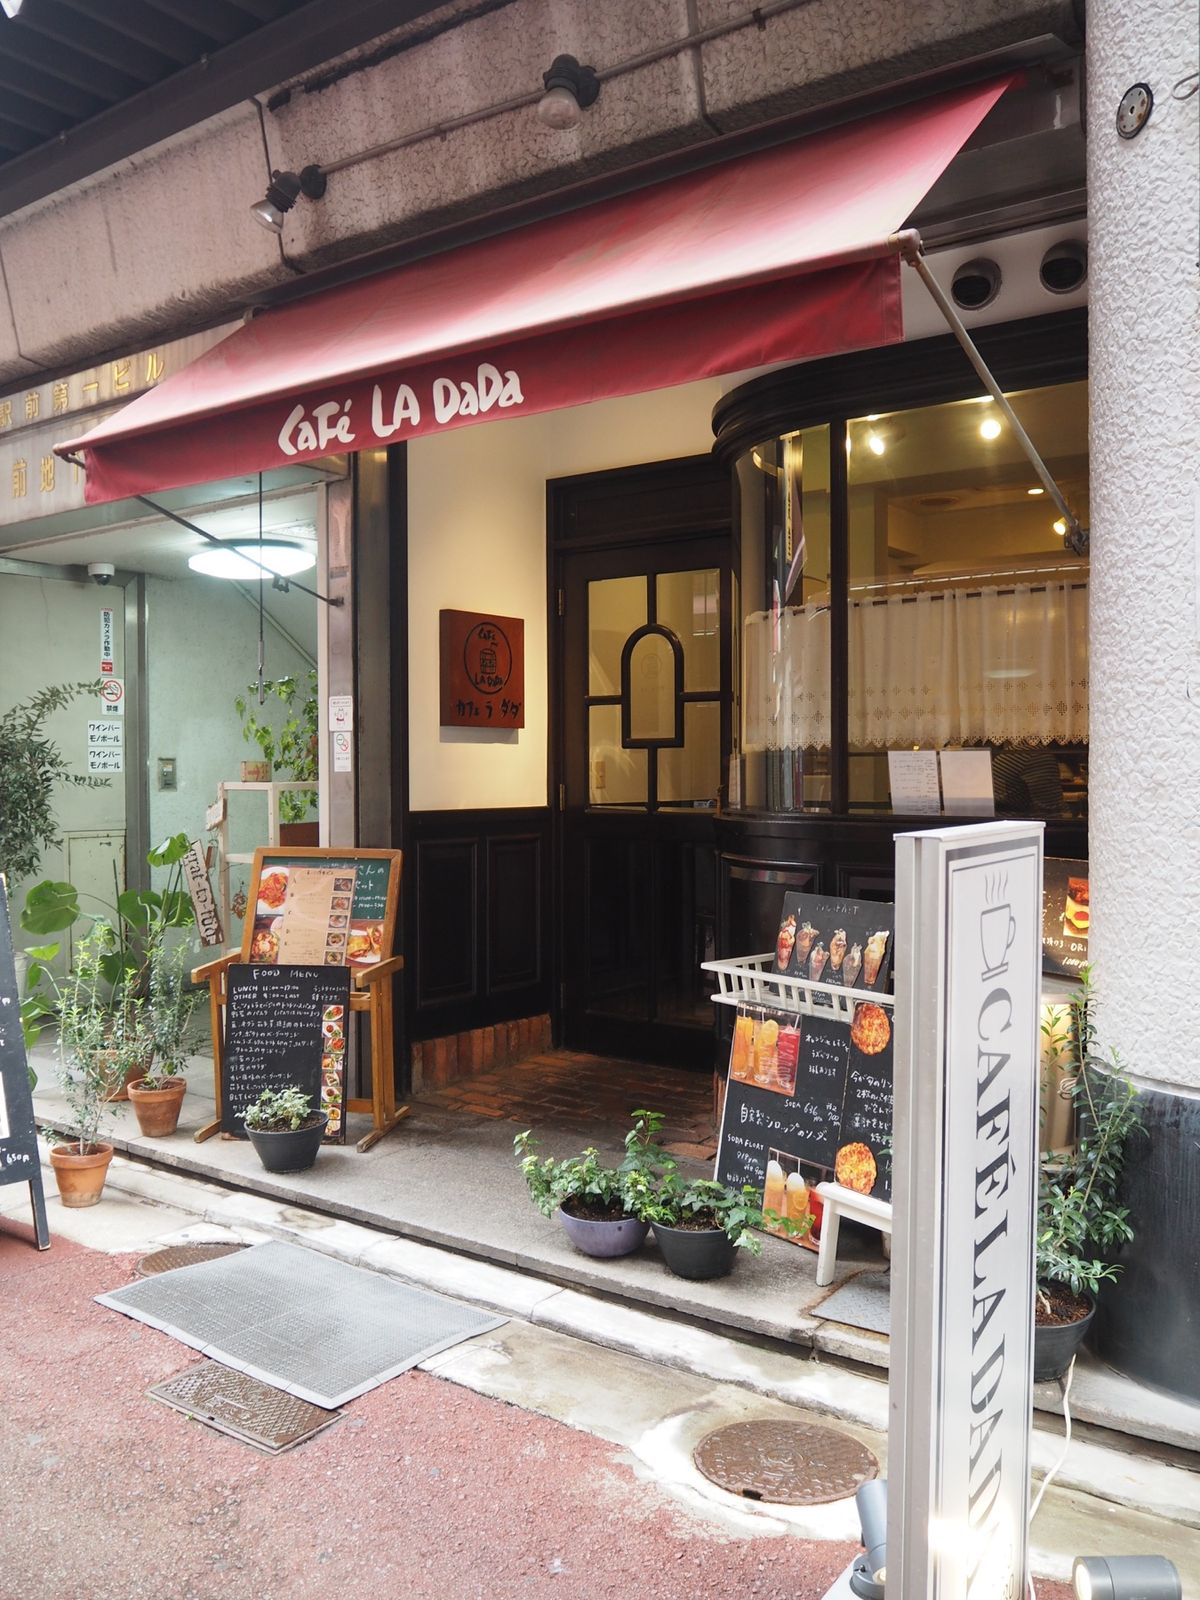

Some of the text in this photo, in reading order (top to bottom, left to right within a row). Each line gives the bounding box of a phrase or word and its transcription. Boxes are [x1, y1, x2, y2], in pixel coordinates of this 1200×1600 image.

[371, 384, 421, 438] LA
[433, 362, 524, 424] DaDa
[103, 611, 111, 657] 防犯カメラ作動中
[233, 985, 258, 994] LUNCH
[253, 968, 319, 980] FOOD MENU
[233, 993, 258, 1001] OTHER
[975, 987, 1016, 1219] CAFÉ
[727, 1133, 764, 1150] SODA FLOAT
[972, 1209, 1009, 1355] LA
